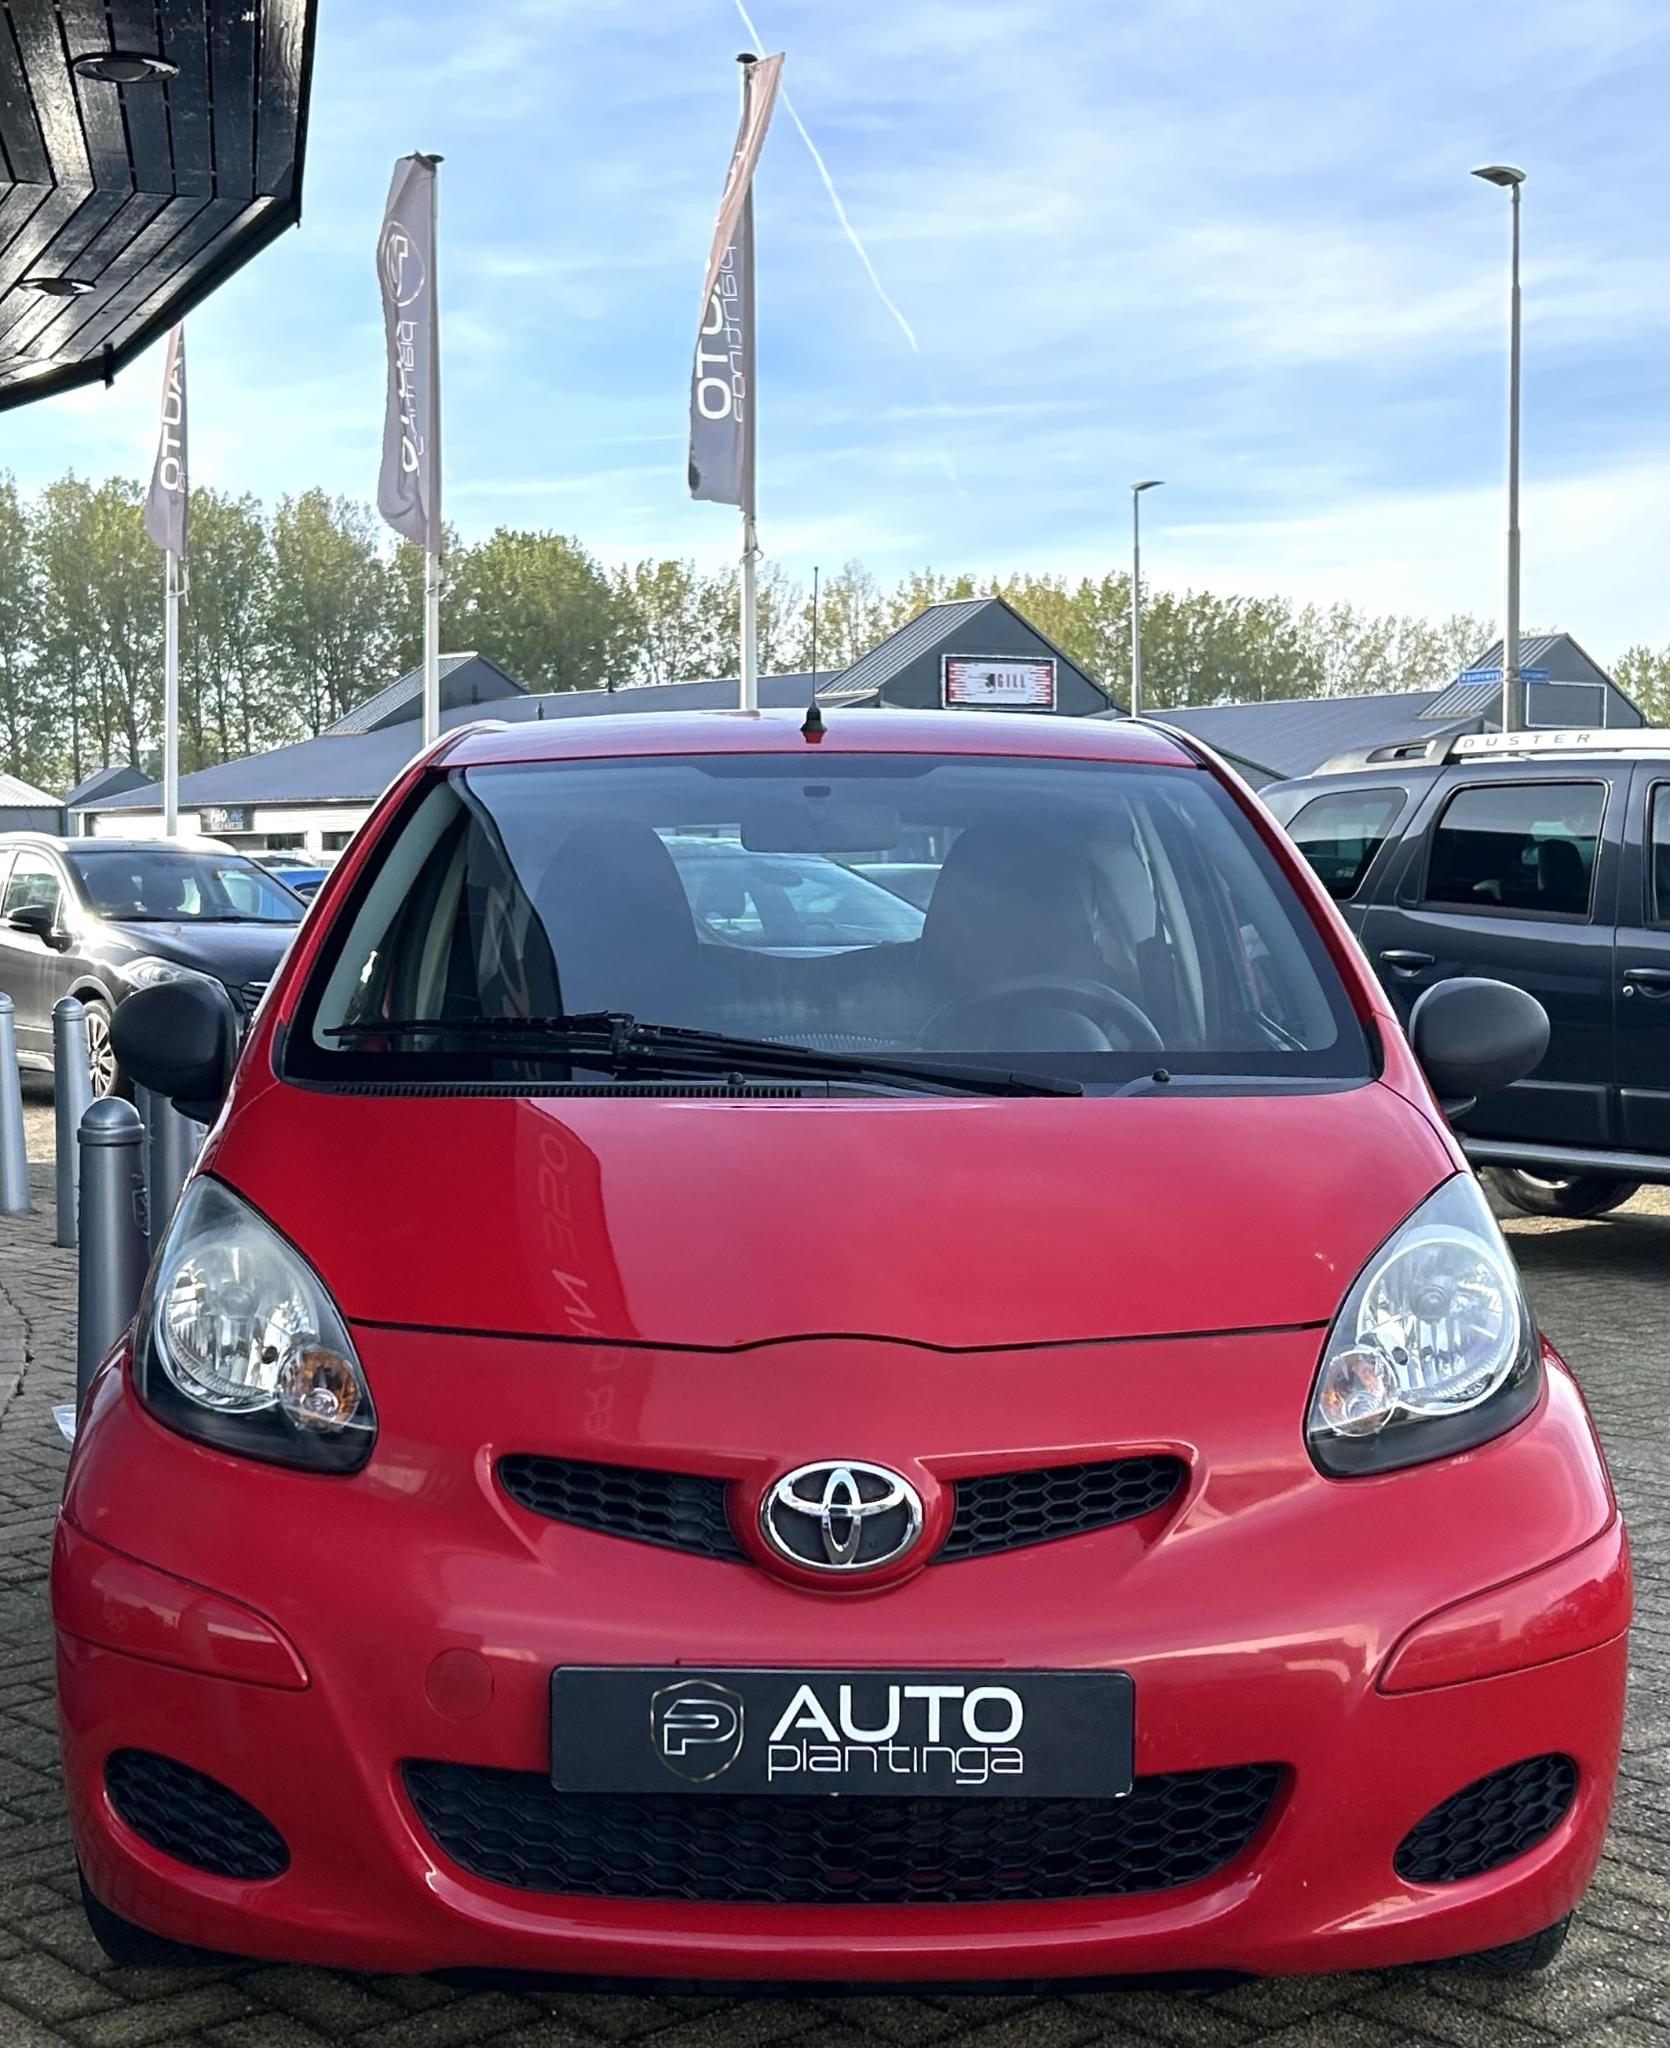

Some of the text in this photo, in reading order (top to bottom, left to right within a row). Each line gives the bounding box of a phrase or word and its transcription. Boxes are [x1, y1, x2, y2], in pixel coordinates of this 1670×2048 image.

[1463, 733, 1591, 749] DUSTER
[768, 1684, 1024, 1744] AUTO
[768, 1738, 1024, 1784] plantinga
